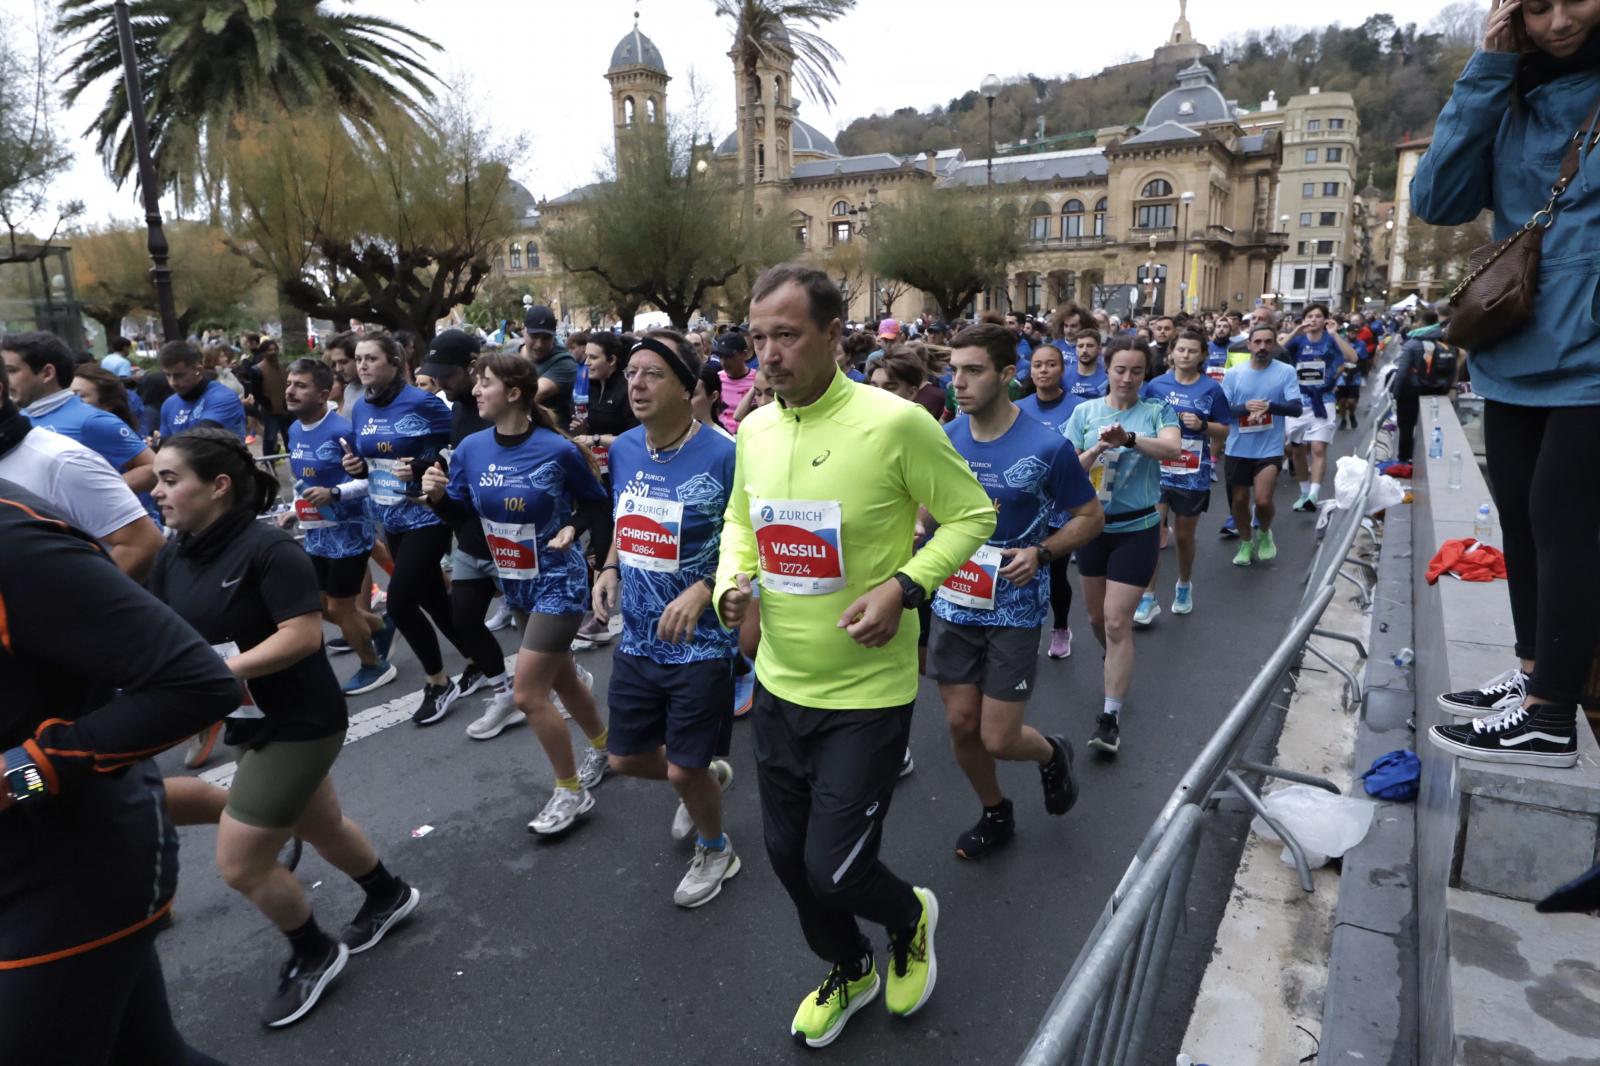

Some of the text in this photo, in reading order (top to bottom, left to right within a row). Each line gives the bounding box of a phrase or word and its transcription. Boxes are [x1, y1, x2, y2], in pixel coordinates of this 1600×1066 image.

[970, 461, 992, 469] ZURICH
[644, 473, 666, 483] ZURICH
[503, 496, 528, 512] 10k
[637, 504, 669, 516] ZURICH
[779, 510, 823, 522] ZURICH
[621, 526, 678, 545] CHRISTIAN
[631, 543, 656, 556] 10864
[771, 541, 827, 558] VASSILI
[779, 561, 812, 575] 12724
[951, 580, 972, 593] 12333
